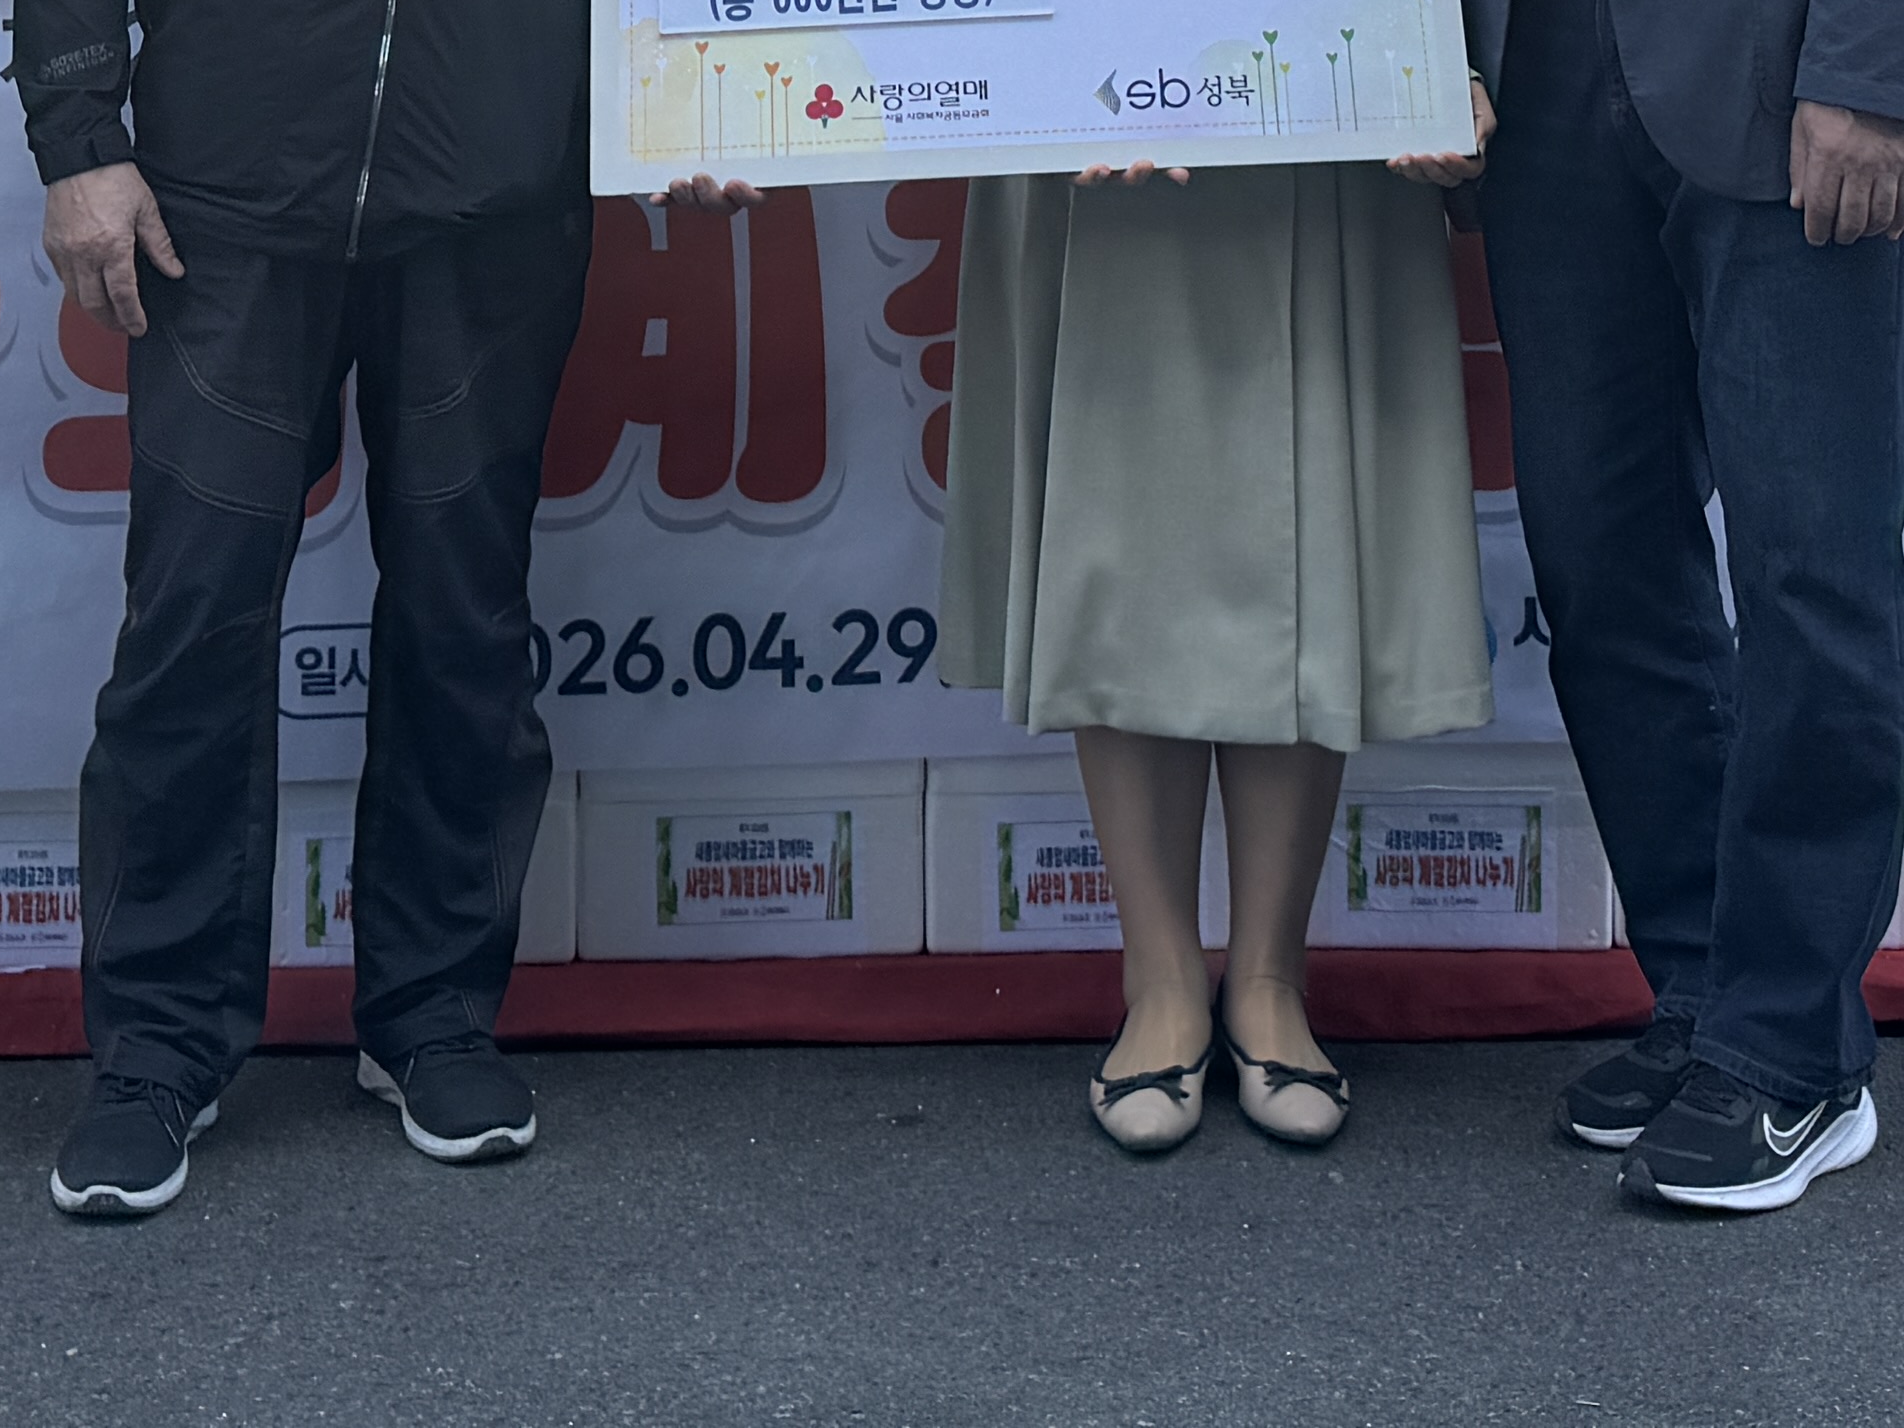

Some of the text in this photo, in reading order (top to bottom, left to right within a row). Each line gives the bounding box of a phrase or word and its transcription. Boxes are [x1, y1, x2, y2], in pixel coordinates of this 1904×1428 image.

[851, 80, 988, 110] 사랑의열매
[1127, 68, 1254, 109] sb 성북
[530, 607, 939, 698] 26.04.29
